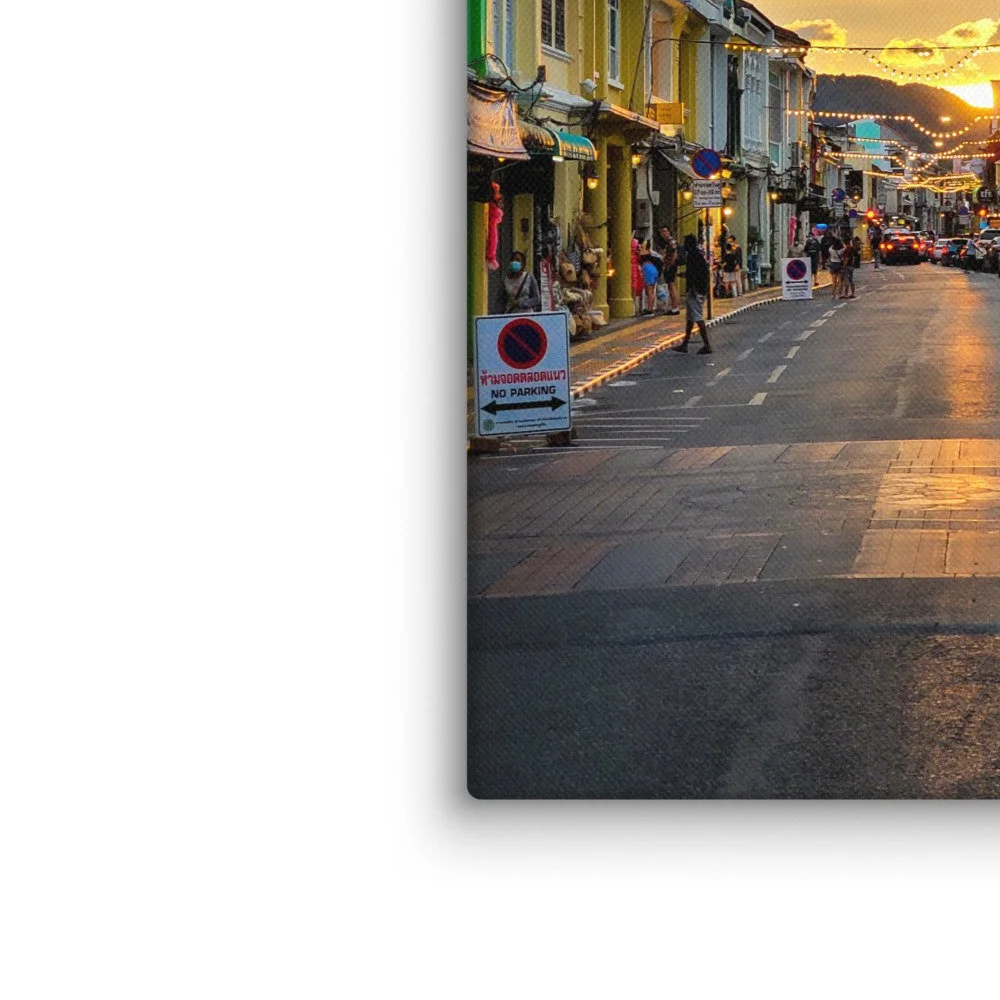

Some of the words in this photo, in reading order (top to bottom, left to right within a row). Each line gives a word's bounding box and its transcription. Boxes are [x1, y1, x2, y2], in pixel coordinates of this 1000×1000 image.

[479, 369, 567, 386] ห้ามจอดตลอดแนว
[491, 389, 507, 398] NO
[510, 386, 556, 397] PARKING
